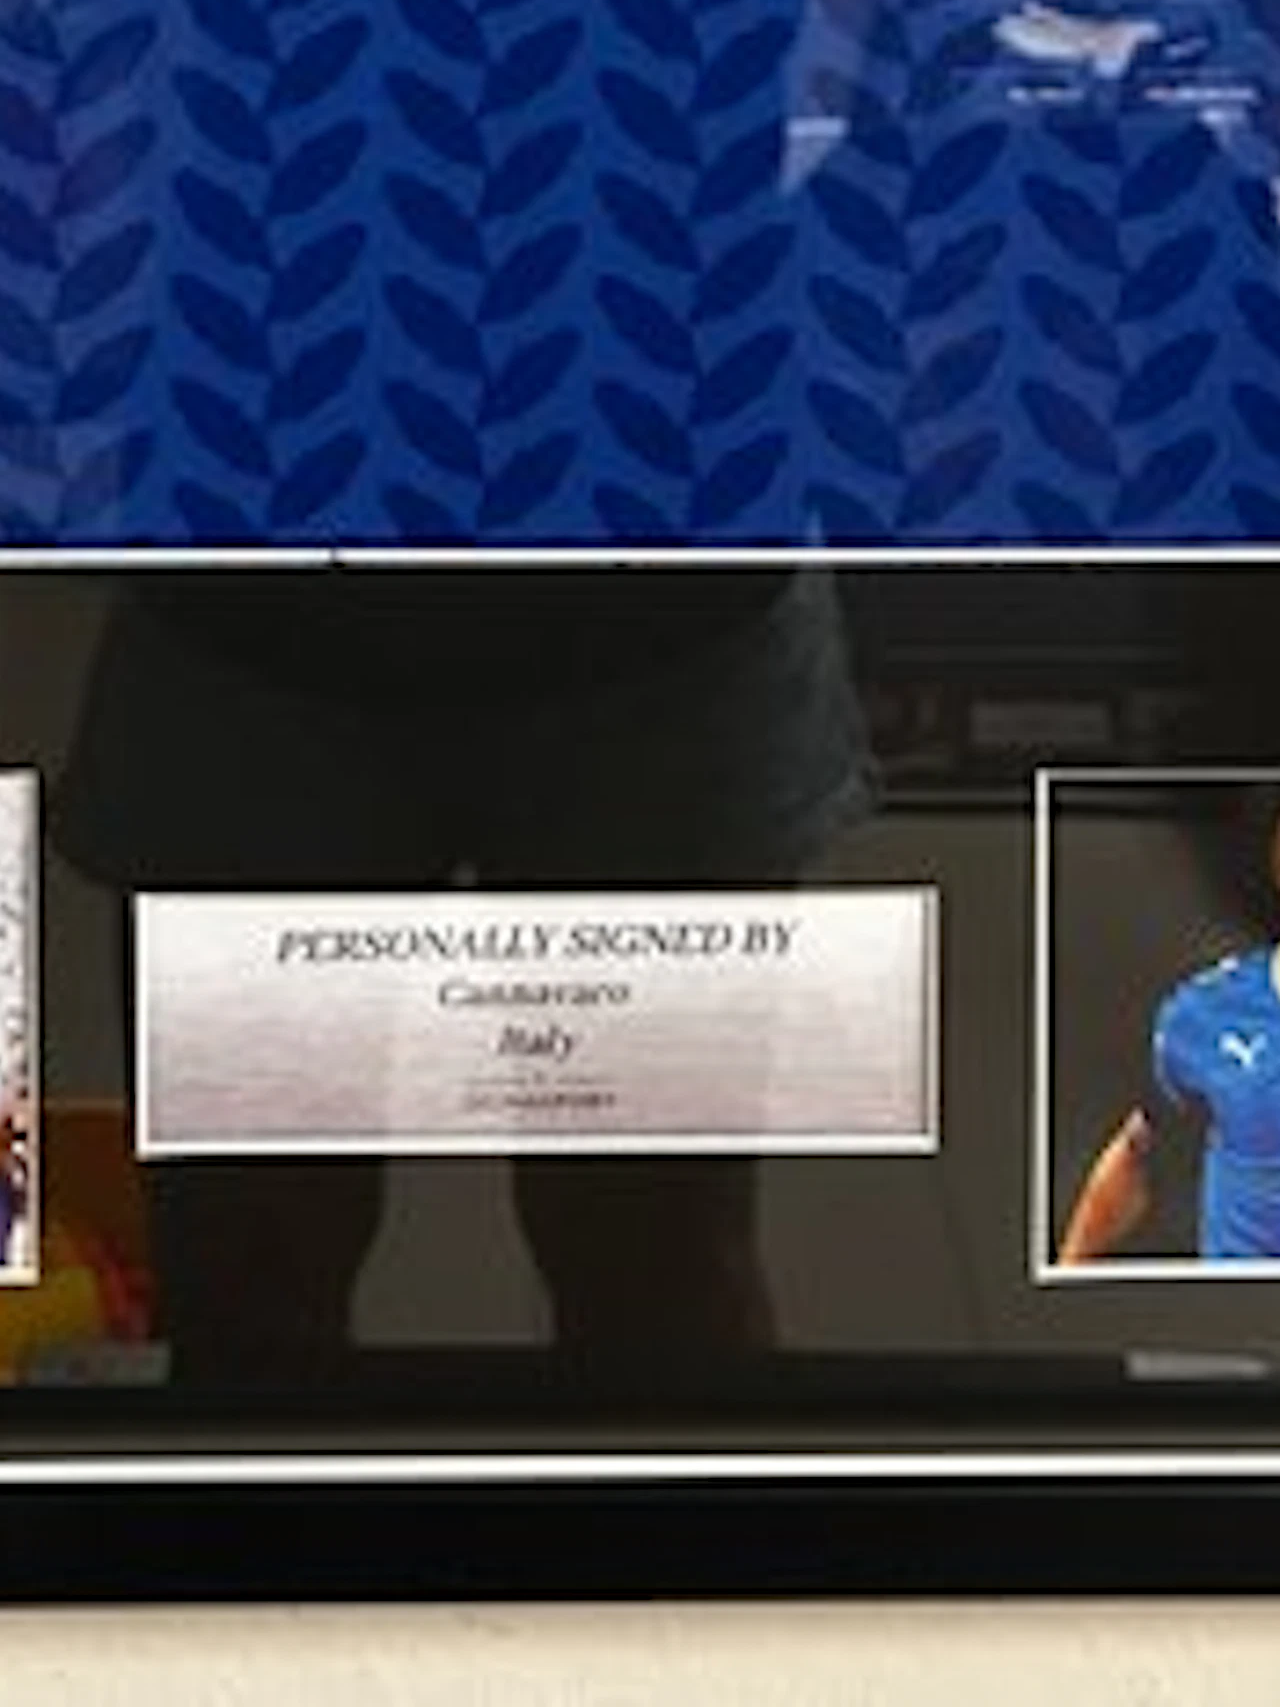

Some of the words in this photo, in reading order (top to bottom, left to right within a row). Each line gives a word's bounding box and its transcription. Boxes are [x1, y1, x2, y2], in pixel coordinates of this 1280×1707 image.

[276, 923, 561, 963] PERSONALLY
[563, 921, 733, 959] SIGNED
[740, 917, 803, 956] BY
[437, 980, 632, 1007] Cannavaro
[497, 1023, 574, 1064] Italy
